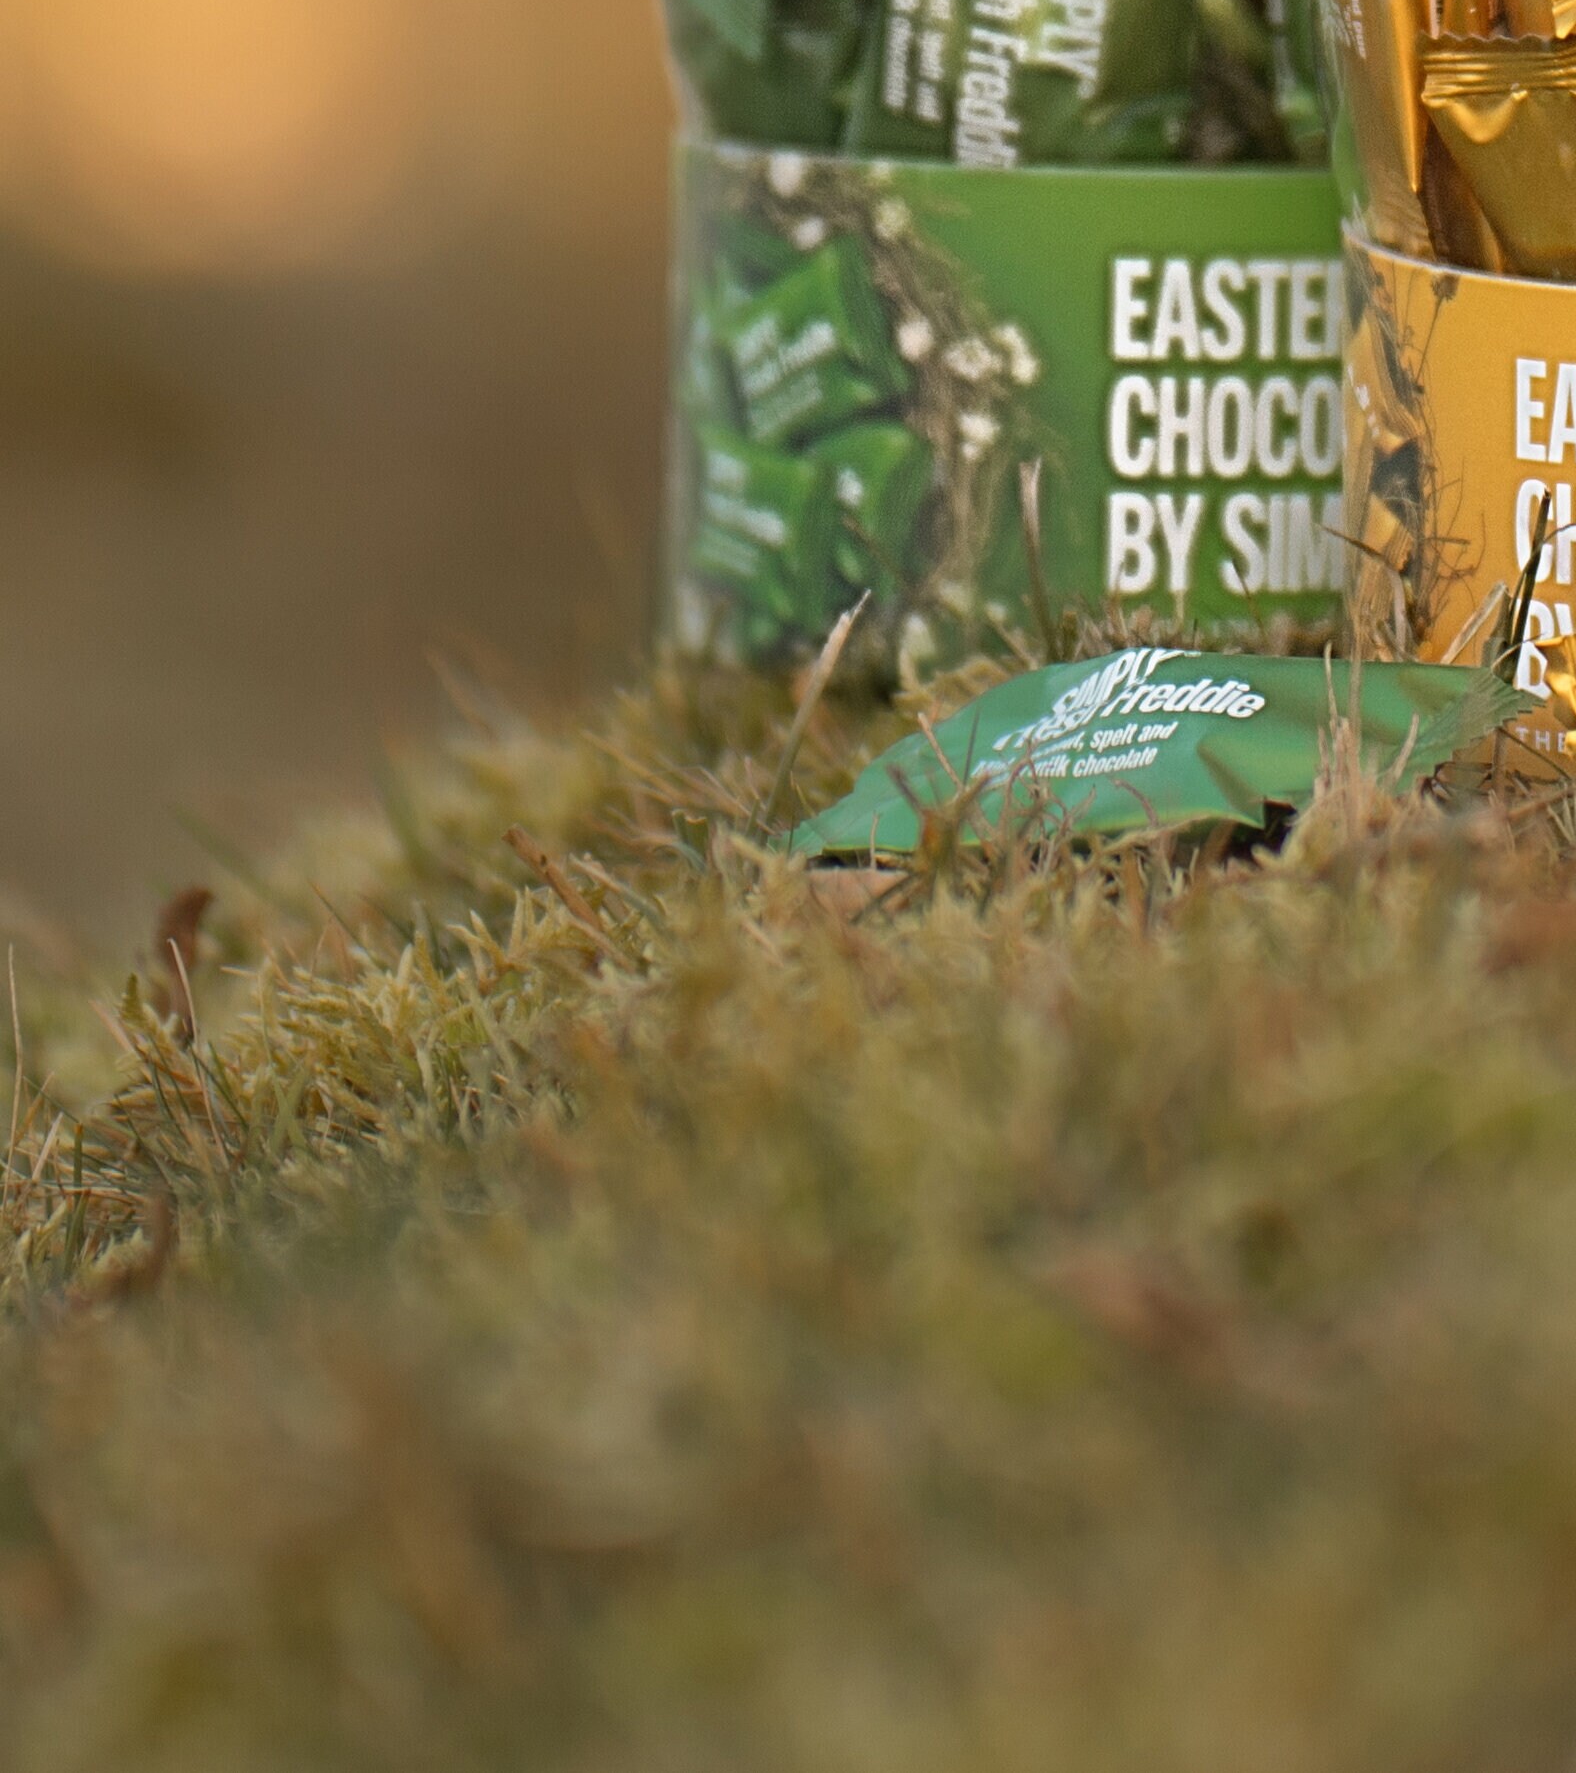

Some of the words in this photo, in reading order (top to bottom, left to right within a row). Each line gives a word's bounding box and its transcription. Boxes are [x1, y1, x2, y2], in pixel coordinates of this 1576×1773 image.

[1108, 491, 1203, 594] BY
[1101, 678, 1265, 719] Freddie
[1090, 722, 1136, 753] spelt
[1137, 721, 1179, 744] and
[1072, 746, 1158, 779] chocolate
